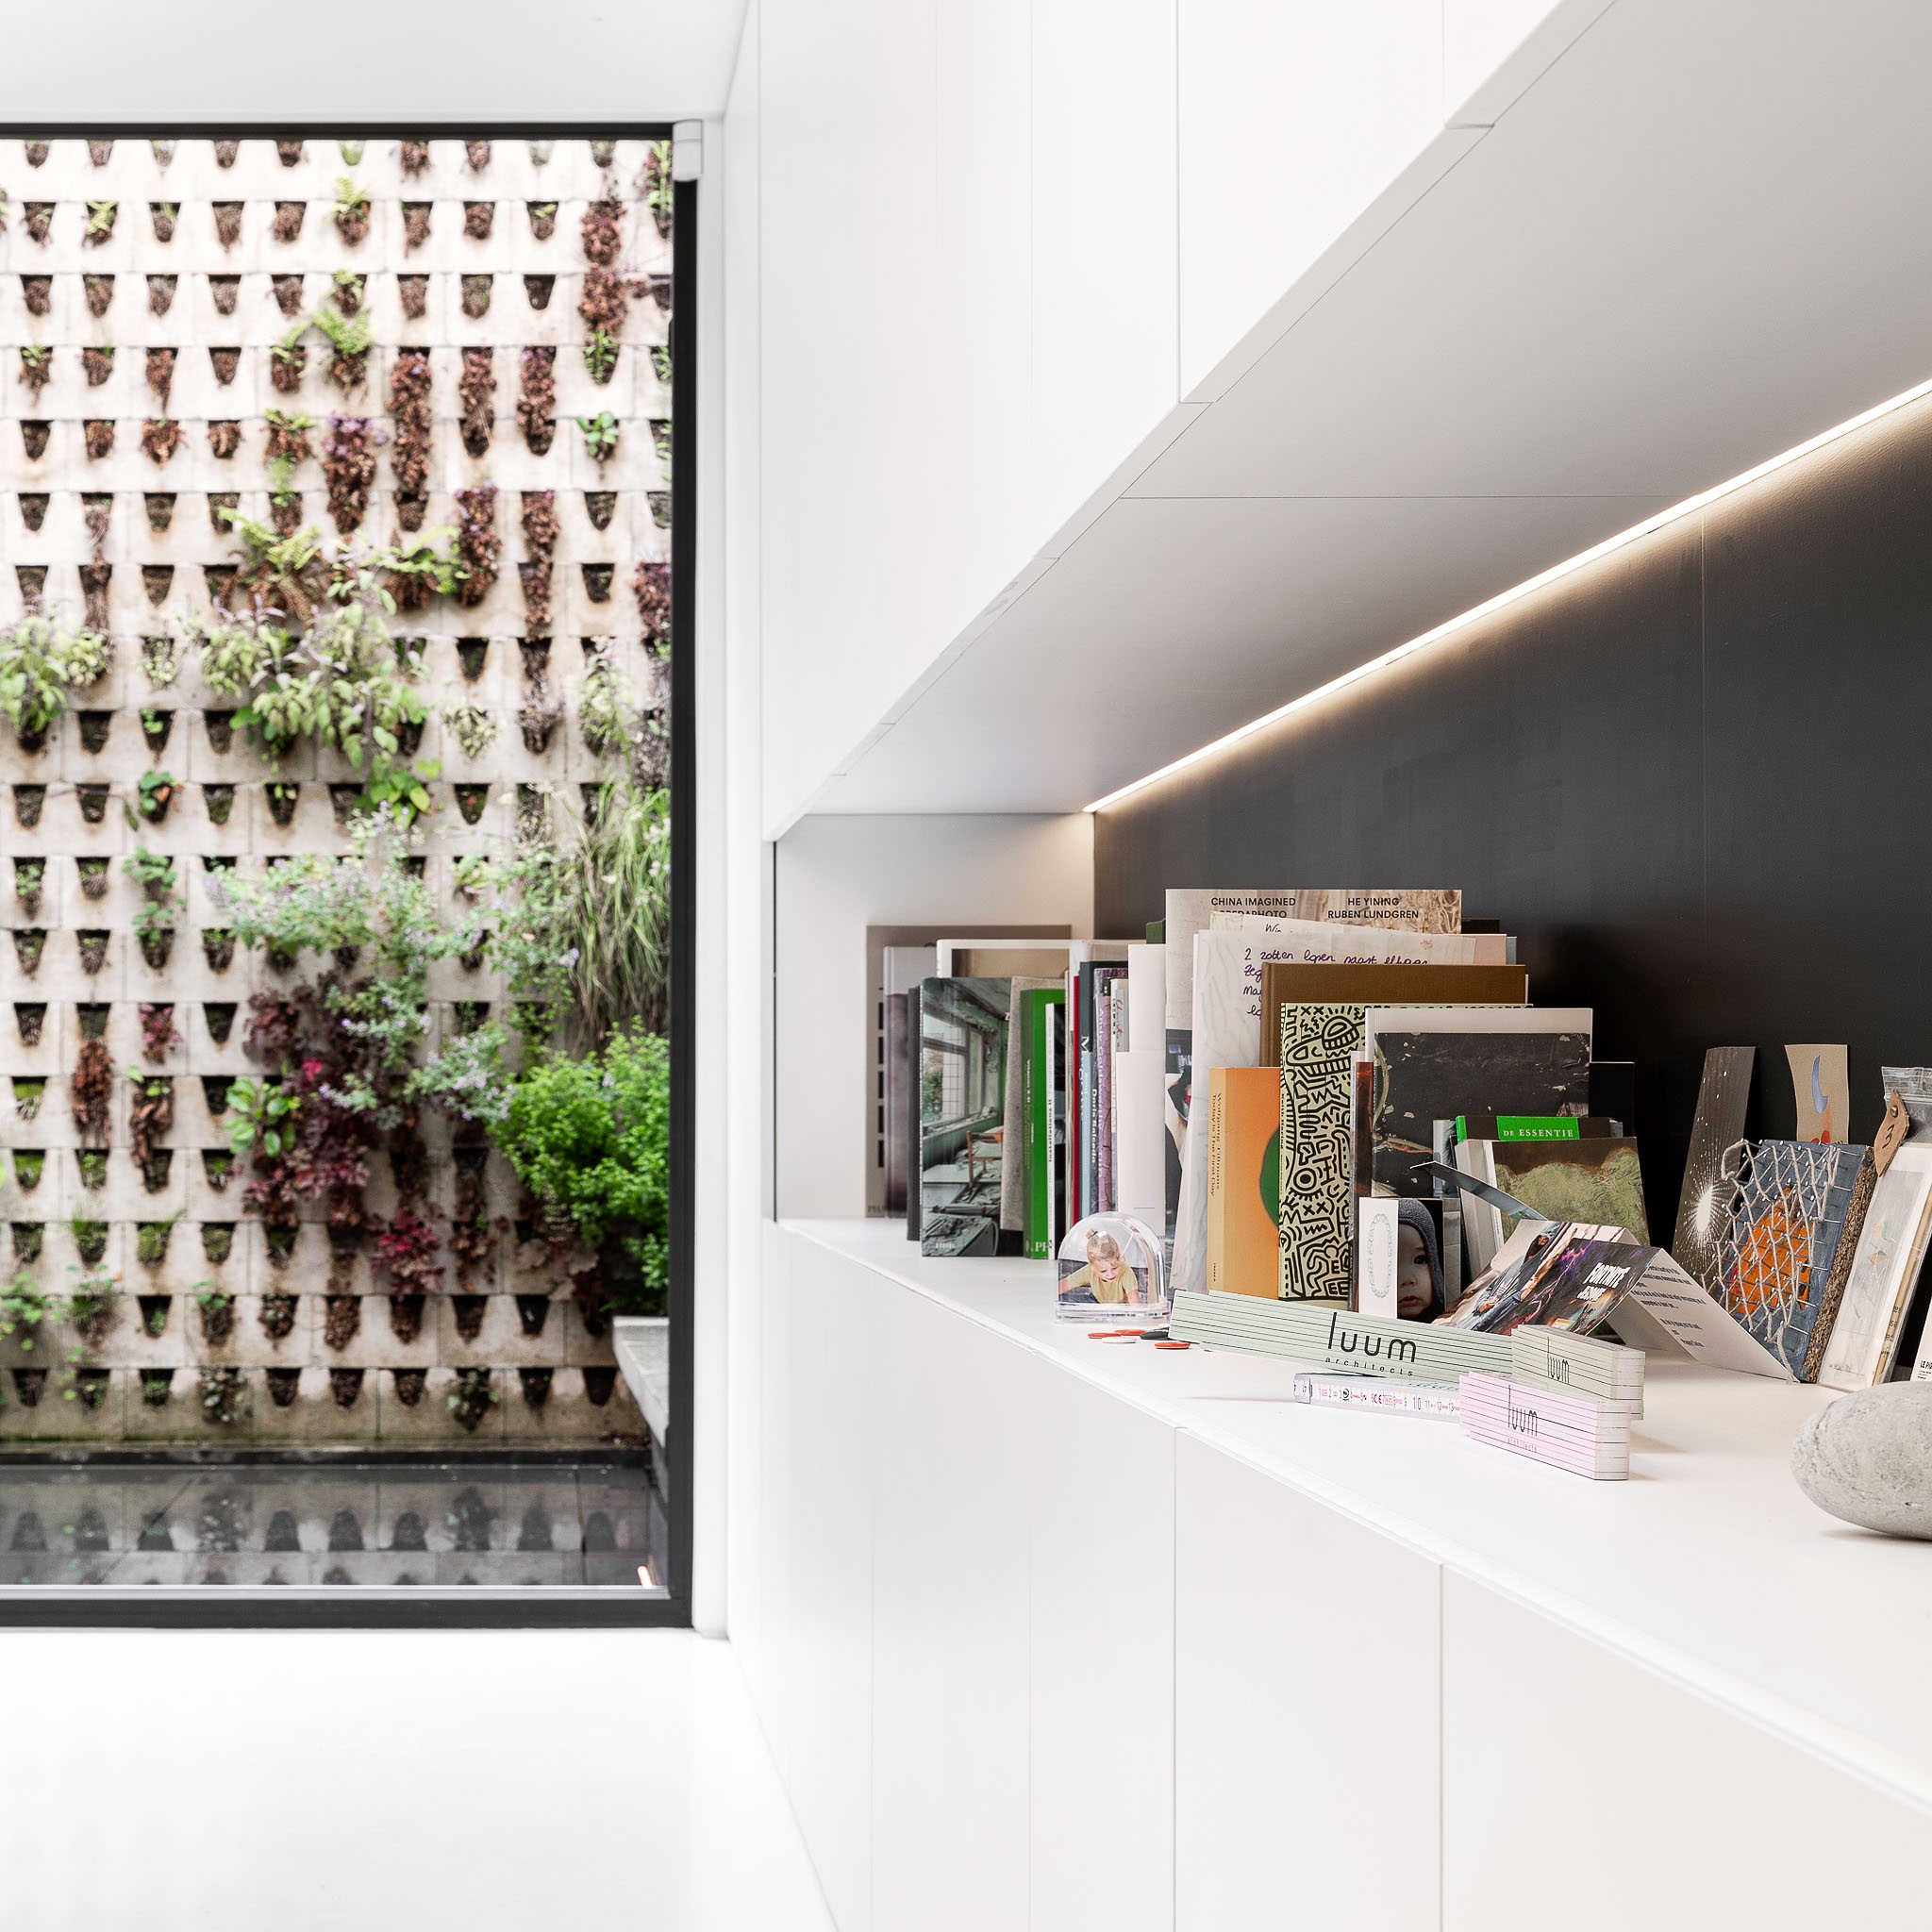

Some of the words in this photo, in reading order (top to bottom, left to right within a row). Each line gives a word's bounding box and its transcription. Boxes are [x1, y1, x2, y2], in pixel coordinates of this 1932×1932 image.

[1211, 897, 1242, 906] CHINA
[1245, 897, 1296, 906] IMAGINED
[1347, 897, 1361, 906] HE
[1363, 897, 1400, 906] YINING
[1220, 910, 1287, 919] APHOTO
[1327, 910, 1361, 919] RUBEN
[1363, 910, 1419, 919] LUNDGREN
[1244, 947, 1252, 960] 2
[1519, 1128, 1574, 1138] ESSENTIE
[1882, 1124, 1895, 1149] 3
[1582, 1261, 1631, 1289] FORTNITE
[1327, 1311, 1416, 1362] luum
[1547, 1336, 1570, 1384] luum
[1324, 1357, 1413, 1377] architects
[1413, 1397, 1422, 1409] 10
[1507, 1384, 1538, 1437] luum
